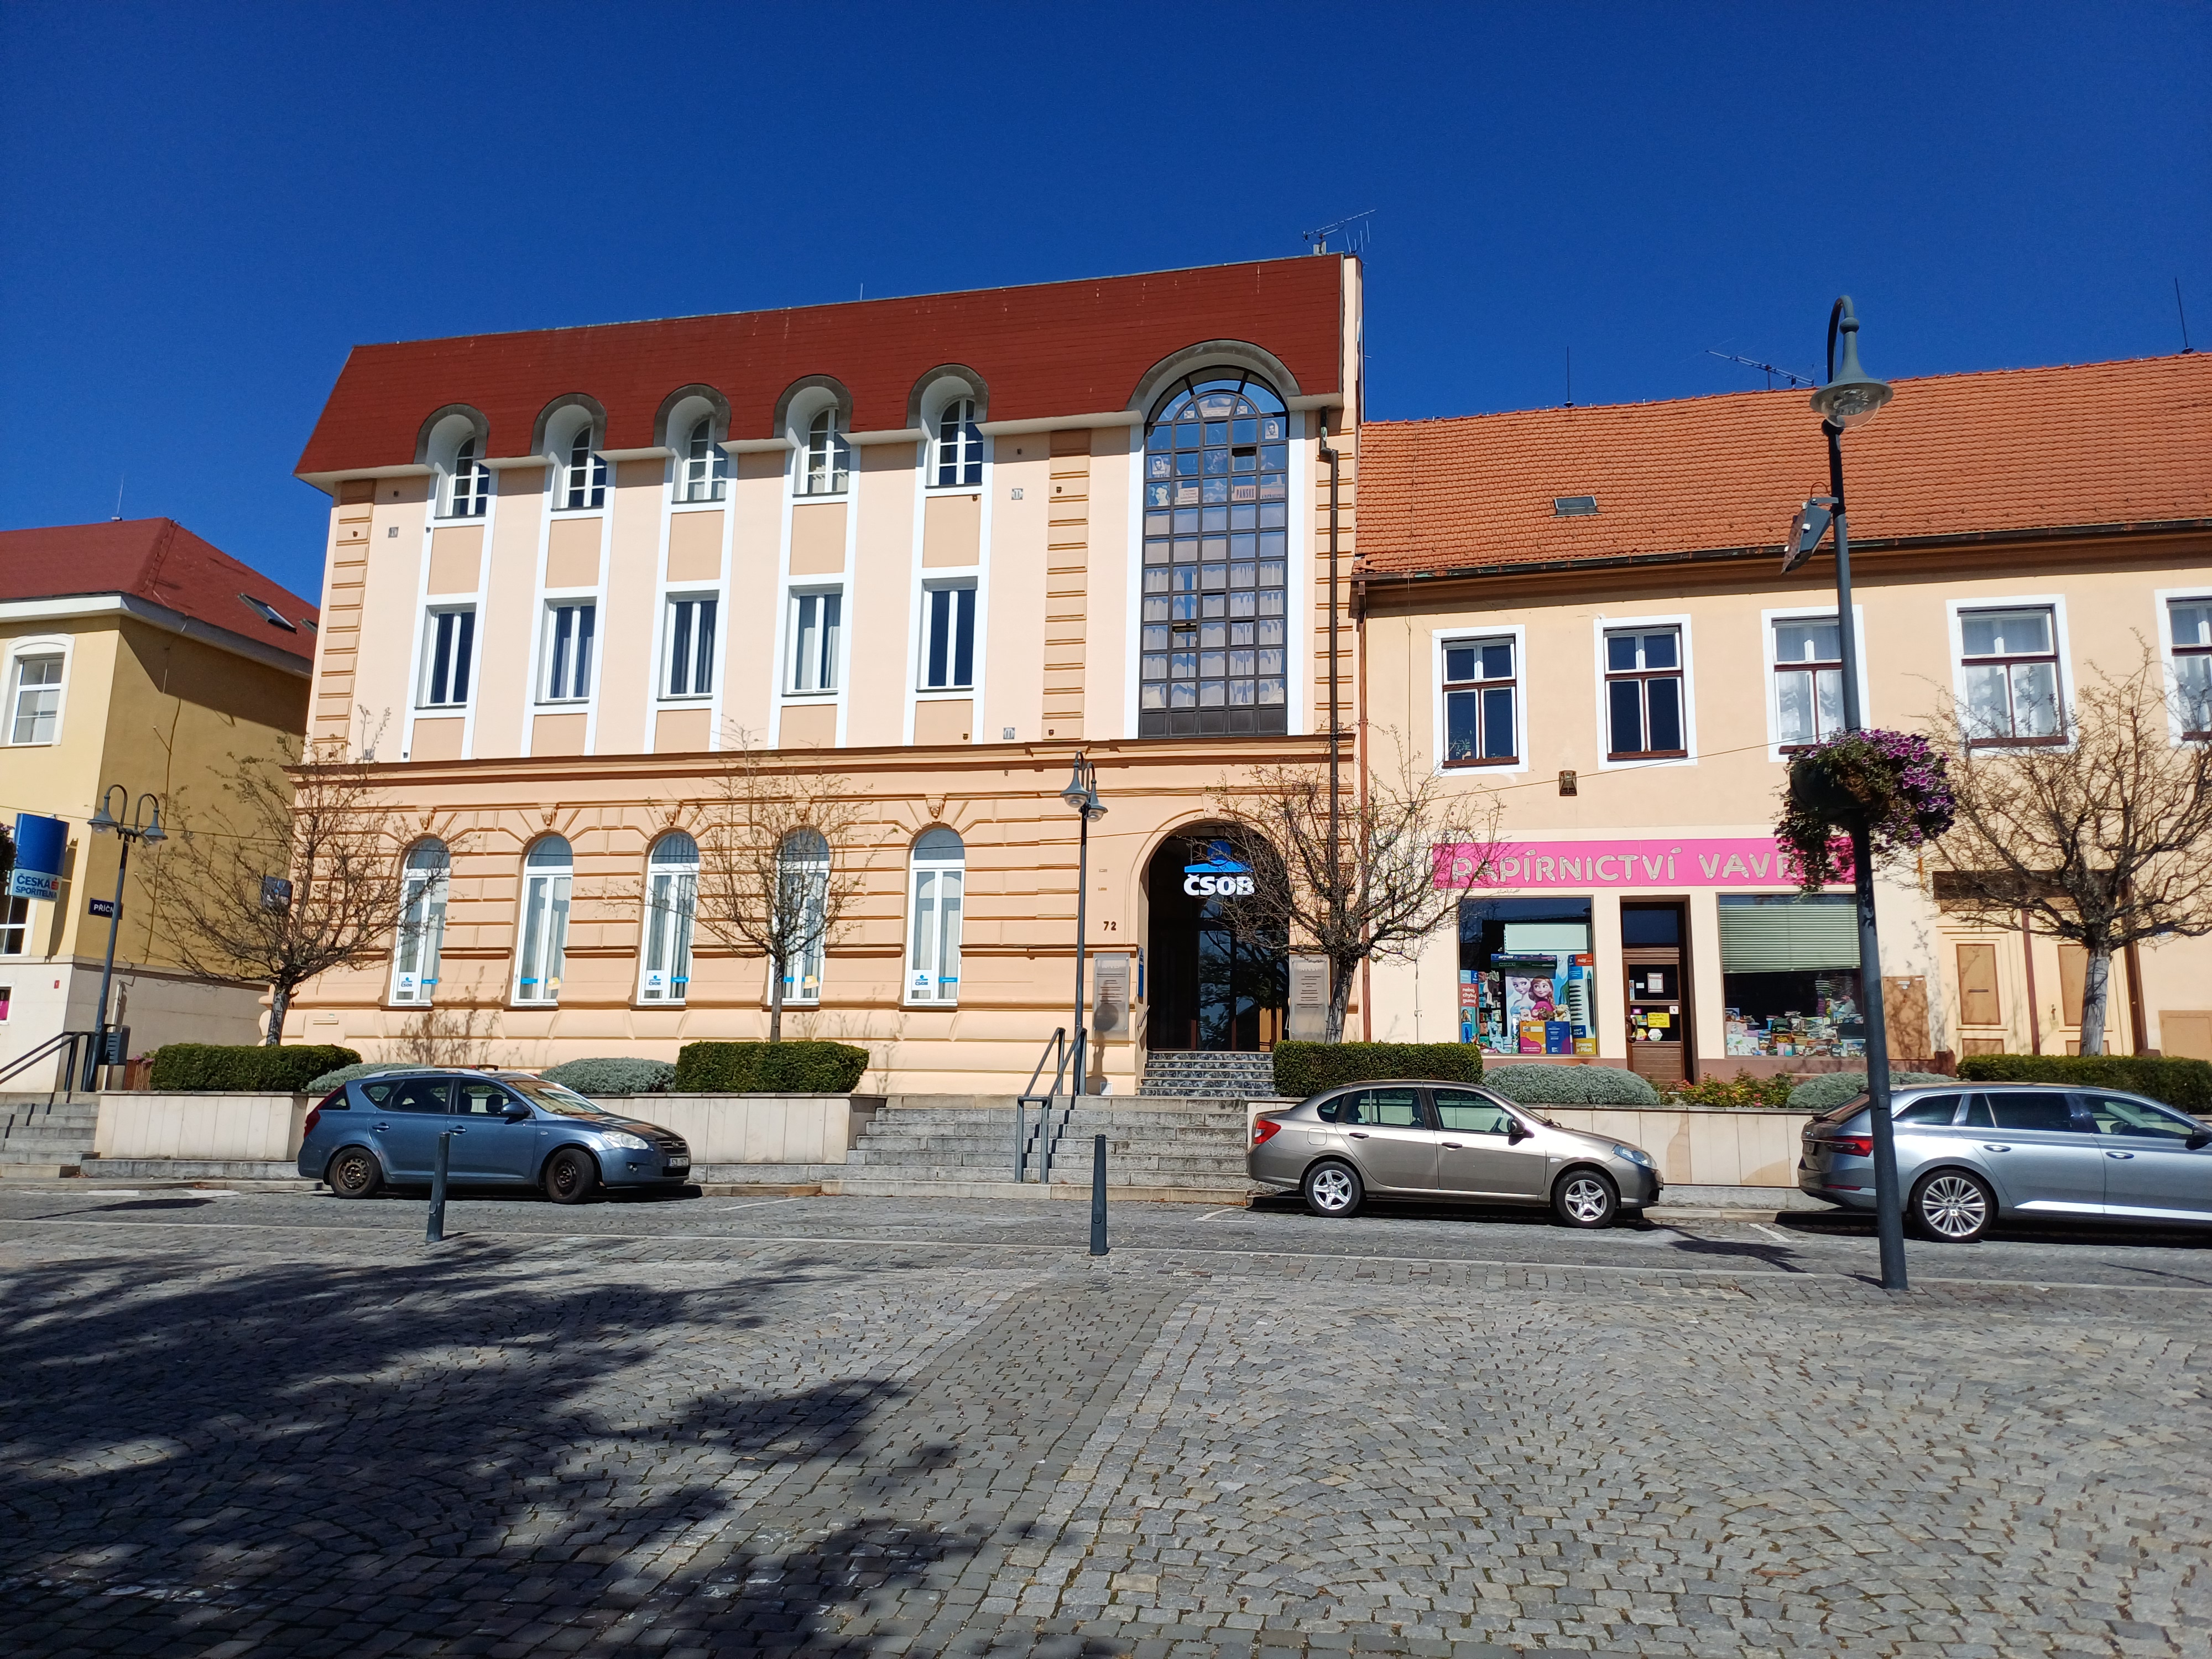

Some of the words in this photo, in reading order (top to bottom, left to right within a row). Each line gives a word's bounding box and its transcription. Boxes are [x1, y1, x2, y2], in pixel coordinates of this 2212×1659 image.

[17, 873, 51, 889] ČESKÁ
[1183, 874, 1255, 896] ČSOB
[15, 886, 58, 899] SPOŘITELNA
[1103, 921, 1117, 931] 72
